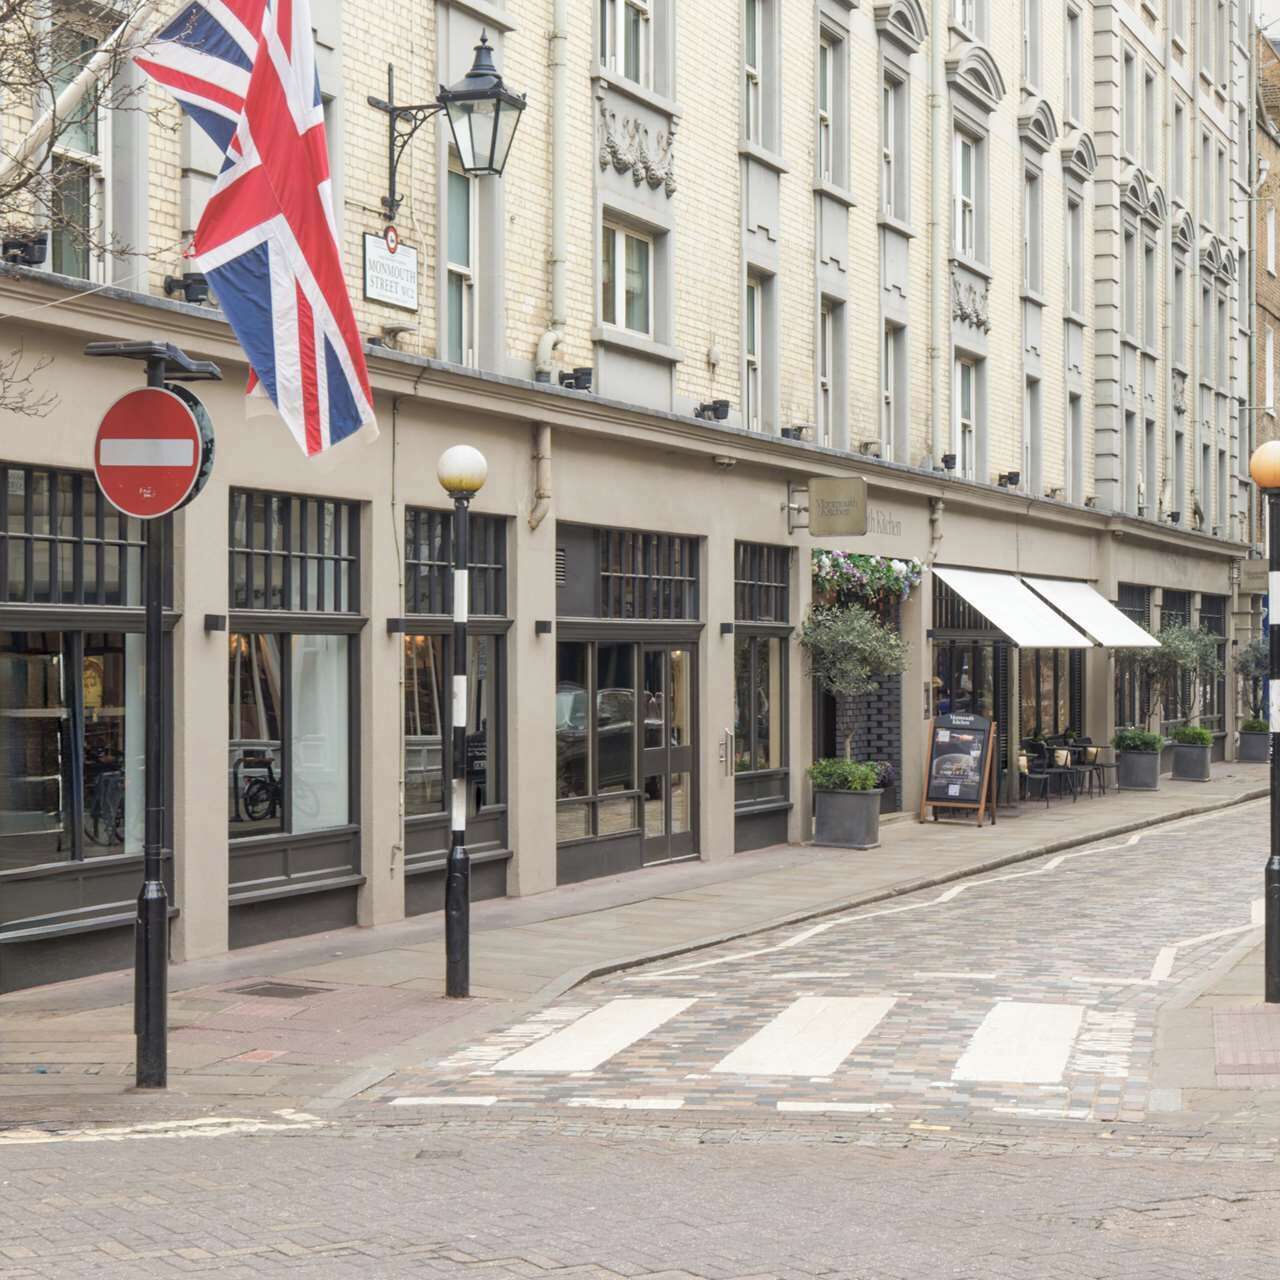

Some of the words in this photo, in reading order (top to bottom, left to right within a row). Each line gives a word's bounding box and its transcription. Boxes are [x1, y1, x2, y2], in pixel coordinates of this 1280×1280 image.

[368, 257, 416, 284] MONMOUTH
[369, 274, 399, 295] STREET
[876, 509, 902, 537] Kitchen
